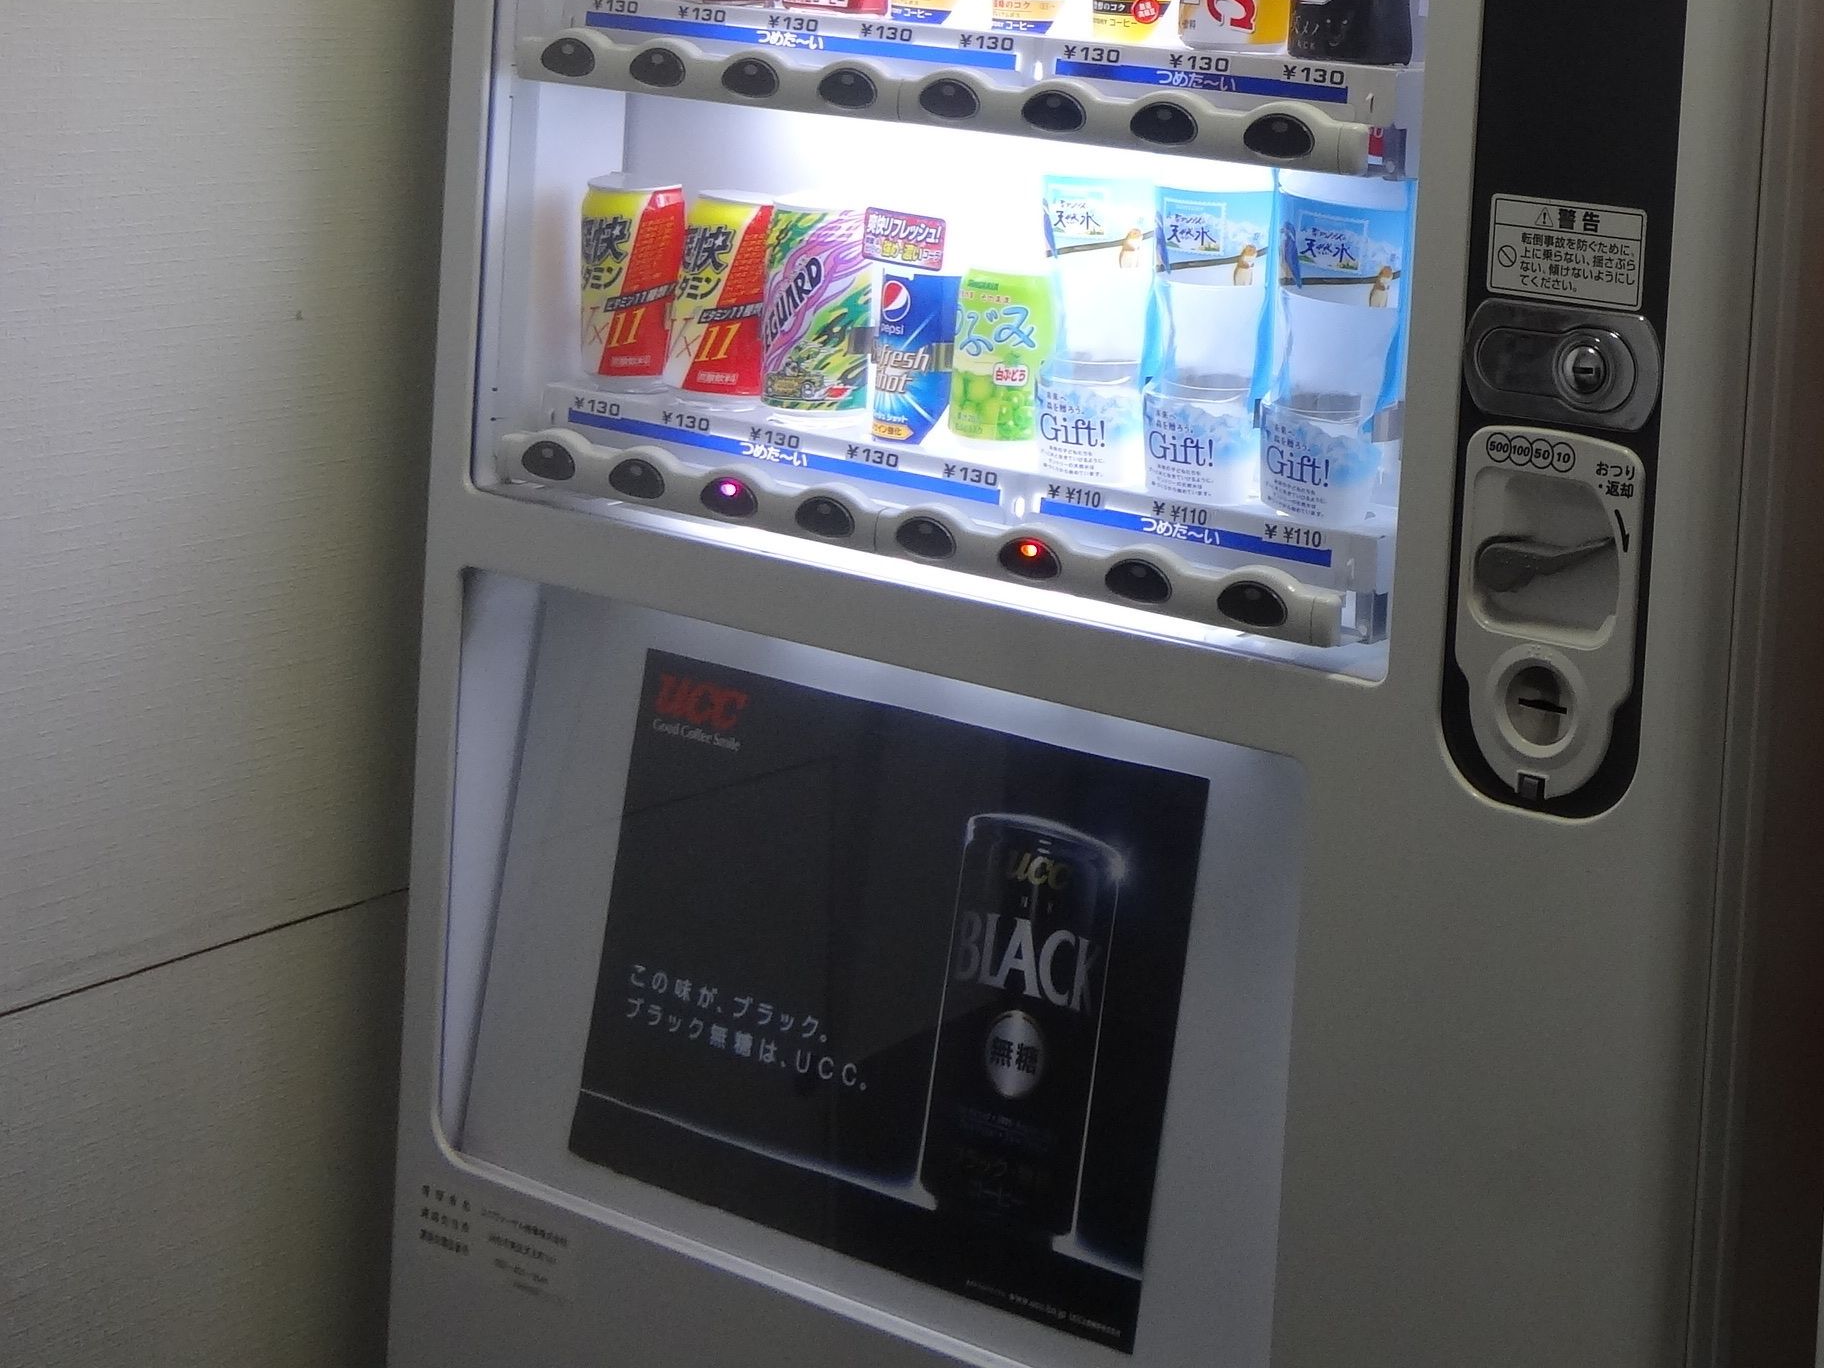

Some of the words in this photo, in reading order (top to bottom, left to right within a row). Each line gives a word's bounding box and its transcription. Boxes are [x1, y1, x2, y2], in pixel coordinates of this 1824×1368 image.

[677, 5, 726, 23] ¥130
[768, 15, 819, 32] ¥130
[860, 23, 912, 42] ¥130
[959, 33, 1015, 52] ¥130
[1063, 44, 1121, 63] ¥130
[1169, 54, 1231, 72] ¥130
[1282, 64, 1345, 85] ¥130
[1557, 208, 1601, 233] 警告
[1521, 232, 1636, 258] 転倒事故を防ぐために、
[1520, 245, 1636, 272] 上に乗らない、揺さぶら
[1519, 259, 1636, 287] ない、傾けないようにし
[1519, 274, 1578, 294] てください。
[607, 307, 647, 350] 11
[695, 322, 742, 363] 11
[574, 396, 621, 417] ¥130
[662, 410, 710, 432] ¥130
[1040, 412, 1106, 448] Gift!
[750, 427, 800, 450] ¥130
[1149, 430, 1214, 468] Gift!
[846, 444, 900, 469] ¥130
[1488, 440, 1510, 454] 500
[1511, 444, 1531, 458] 100
[1533, 448, 1551, 461] 50
[1556, 452, 1571, 465] 10
[942, 463, 998, 487] ¥130
[1265, 445, 1331, 488] Gift!
[1595, 461, 1636, 481] おつり
[1065, 488, 1102, 508] ¥110
[1170, 505, 1207, 526] ¥110
[1283, 526, 1322, 549] ¥110
[954, 912, 1100, 1017] BLACK
[628, 963, 830, 1044] この味が、ブラック。
[625, 996, 870, 1093] ブラック無糖は、UCC。
[989, 1036, 1041, 1077] 無糖
